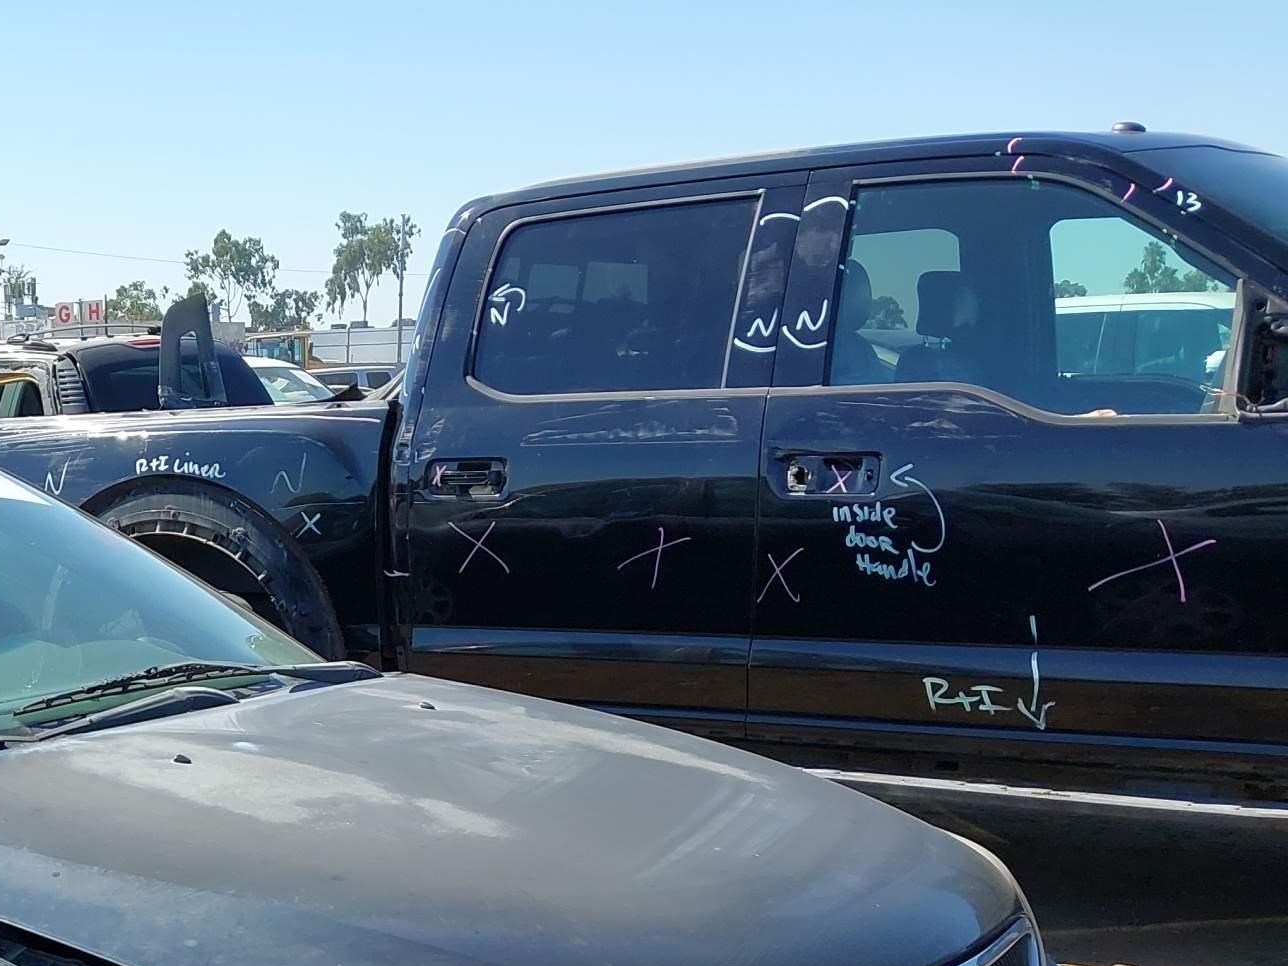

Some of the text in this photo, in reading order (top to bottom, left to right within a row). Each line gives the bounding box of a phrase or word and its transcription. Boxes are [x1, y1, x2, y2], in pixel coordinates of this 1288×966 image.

[1176, 190, 1202, 212] 13
[58, 302, 100, 323] G H
